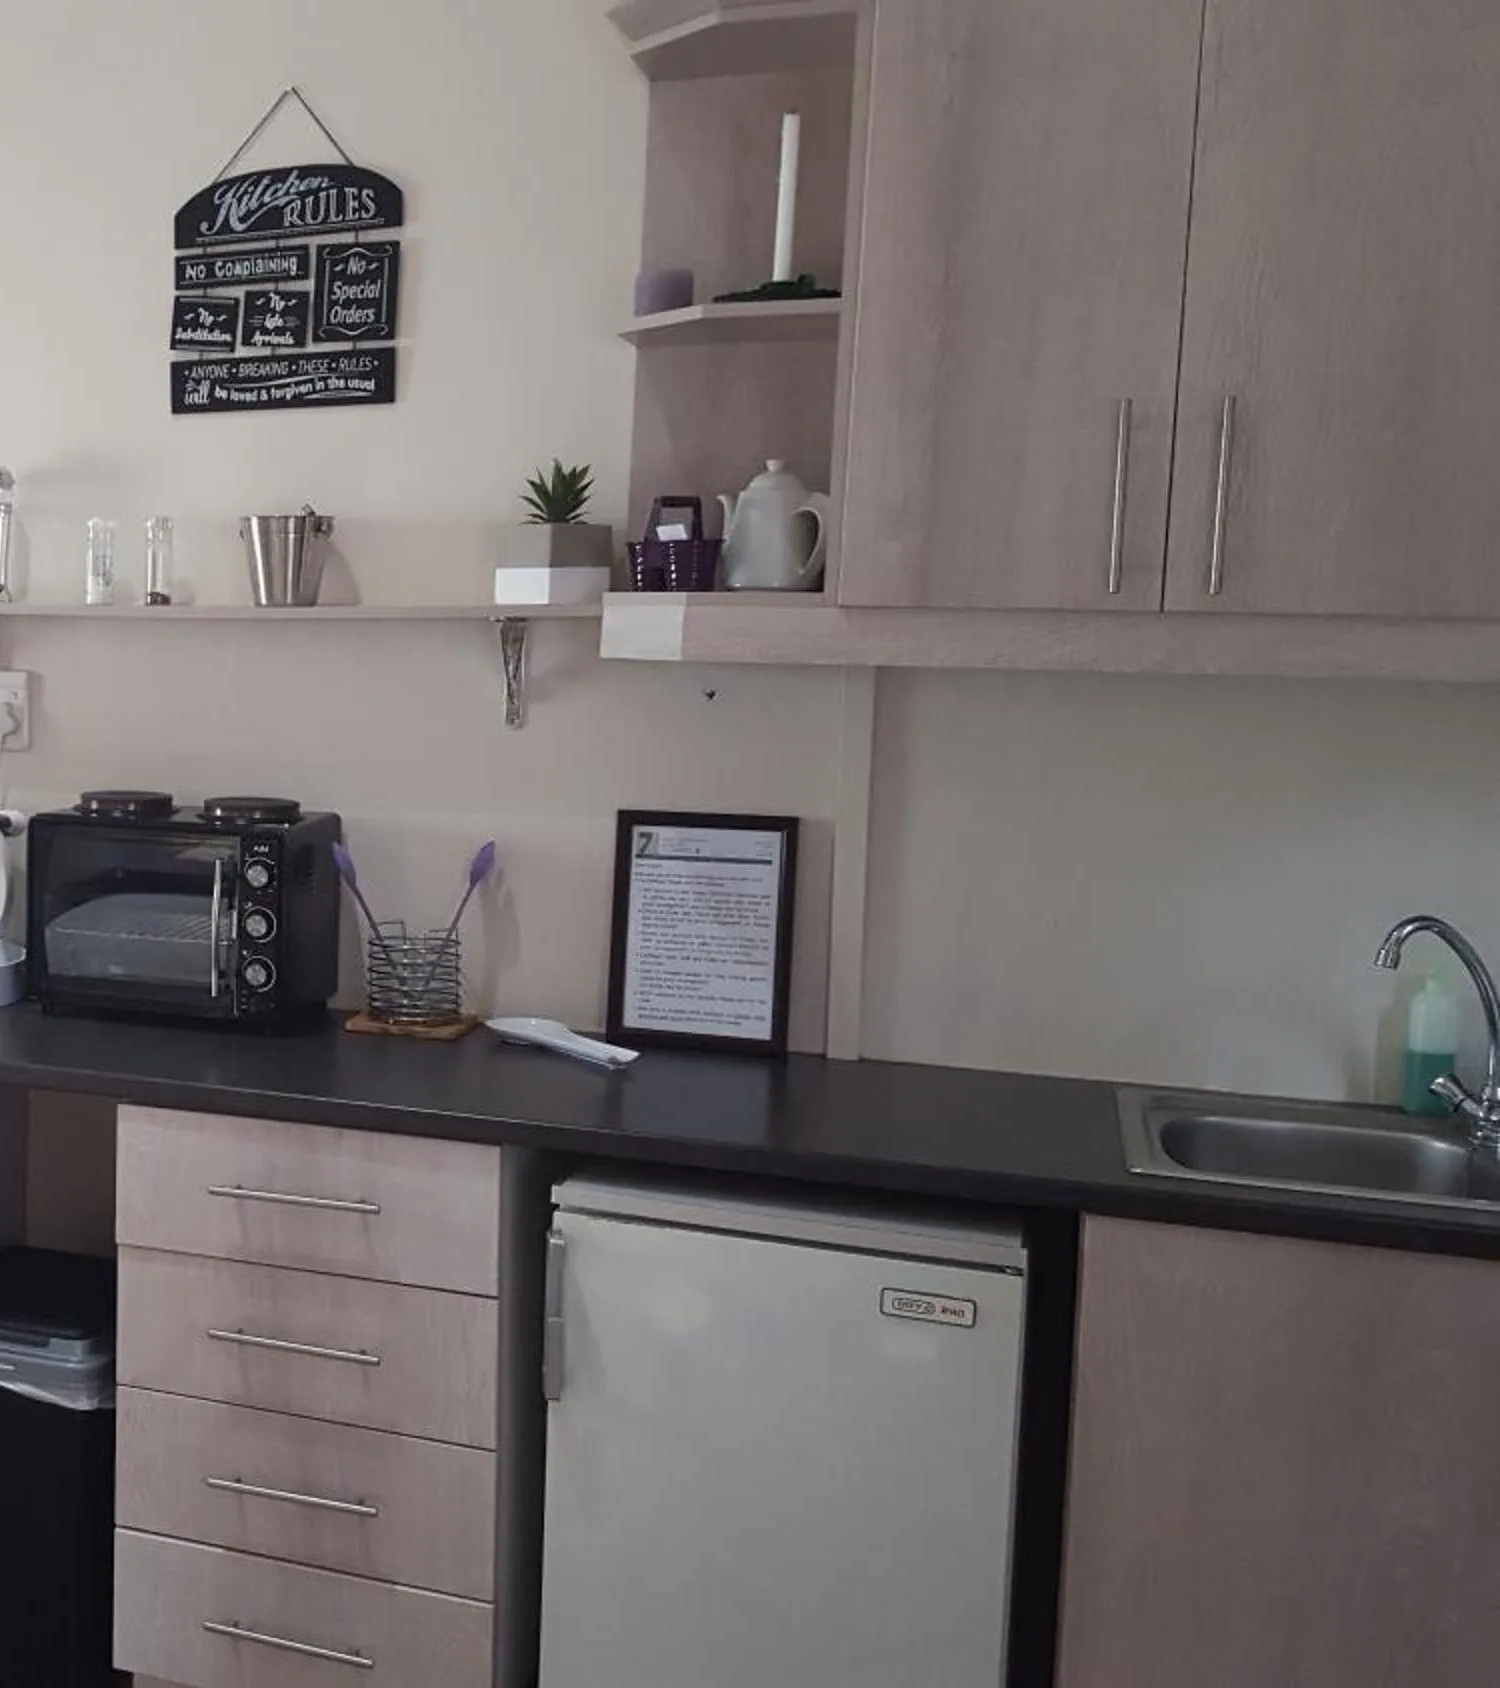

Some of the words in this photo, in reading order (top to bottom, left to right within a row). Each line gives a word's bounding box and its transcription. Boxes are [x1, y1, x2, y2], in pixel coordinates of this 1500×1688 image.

[200, 170, 336, 235] Kitchen
[283, 187, 377, 227] RULES
[185, 264, 206, 281] NO
[347, 256, 366, 275] No
[331, 279, 381, 304] Special
[330, 303, 376, 323] Orders
[238, 361, 289, 377] BREAKING
[299, 359, 329, 374] THESE
[338, 357, 373, 371] RULES
[215, 384, 228, 399] be
[230, 386, 258, 402] loved
[270, 383, 313, 401] forgiven
[315, 376, 325, 391] in
[326, 374, 346, 389] the
[347, 377, 375, 393] usual
